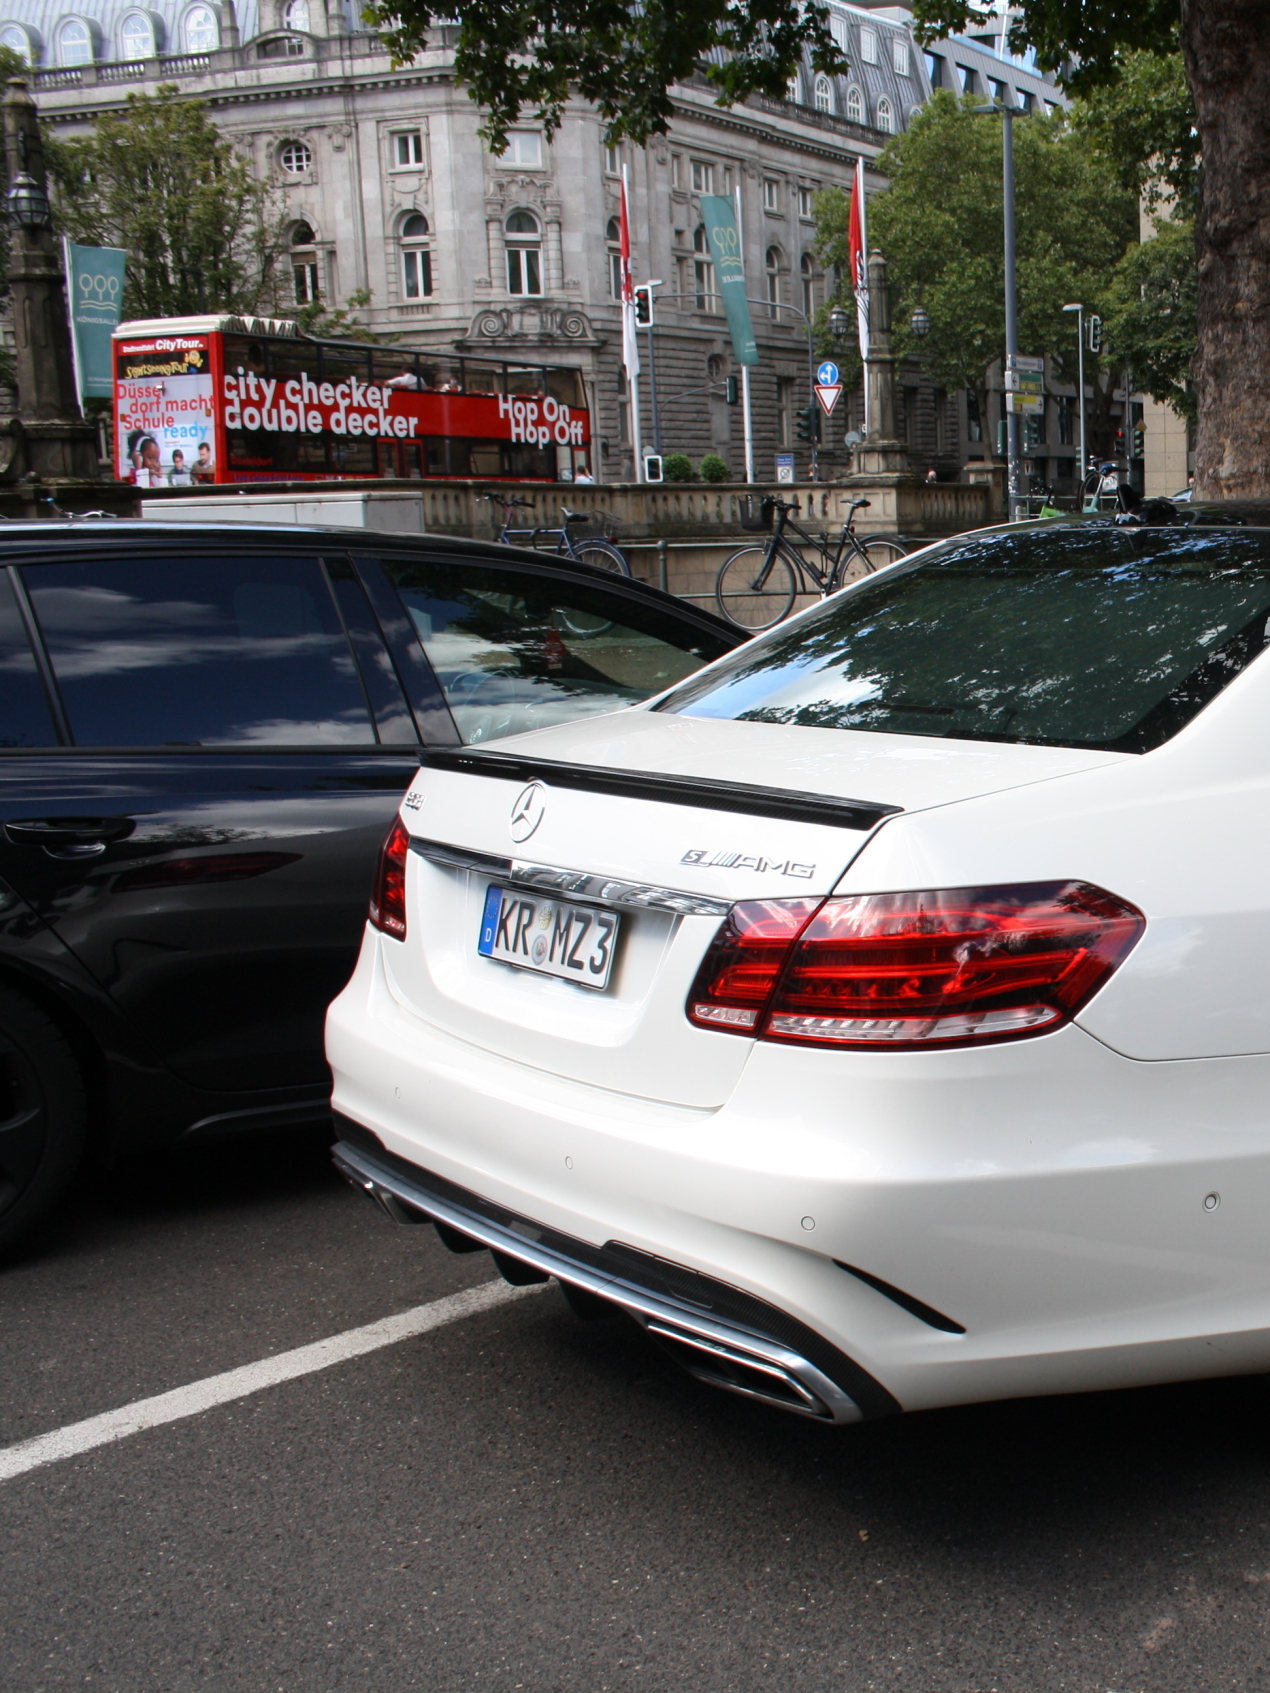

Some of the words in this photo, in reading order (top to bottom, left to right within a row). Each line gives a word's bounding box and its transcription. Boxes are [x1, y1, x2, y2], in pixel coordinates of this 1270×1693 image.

[224, 366, 277, 409] city
[285, 372, 392, 409] checker
[129, 397, 161, 414] dorf
[225, 396, 323, 433] double
[330, 402, 418, 438] decker
[499, 394, 538, 429] Hop
[543, 397, 569, 421] On
[123, 412, 175, 430] Schule
[163, 422, 209, 441] ready
[511, 419, 550, 449] Hop
[555, 421, 583, 445] Off
[485, 929, 492, 942] D
[495, 898, 537, 956] KR
[549, 908, 615, 975] MZ3
